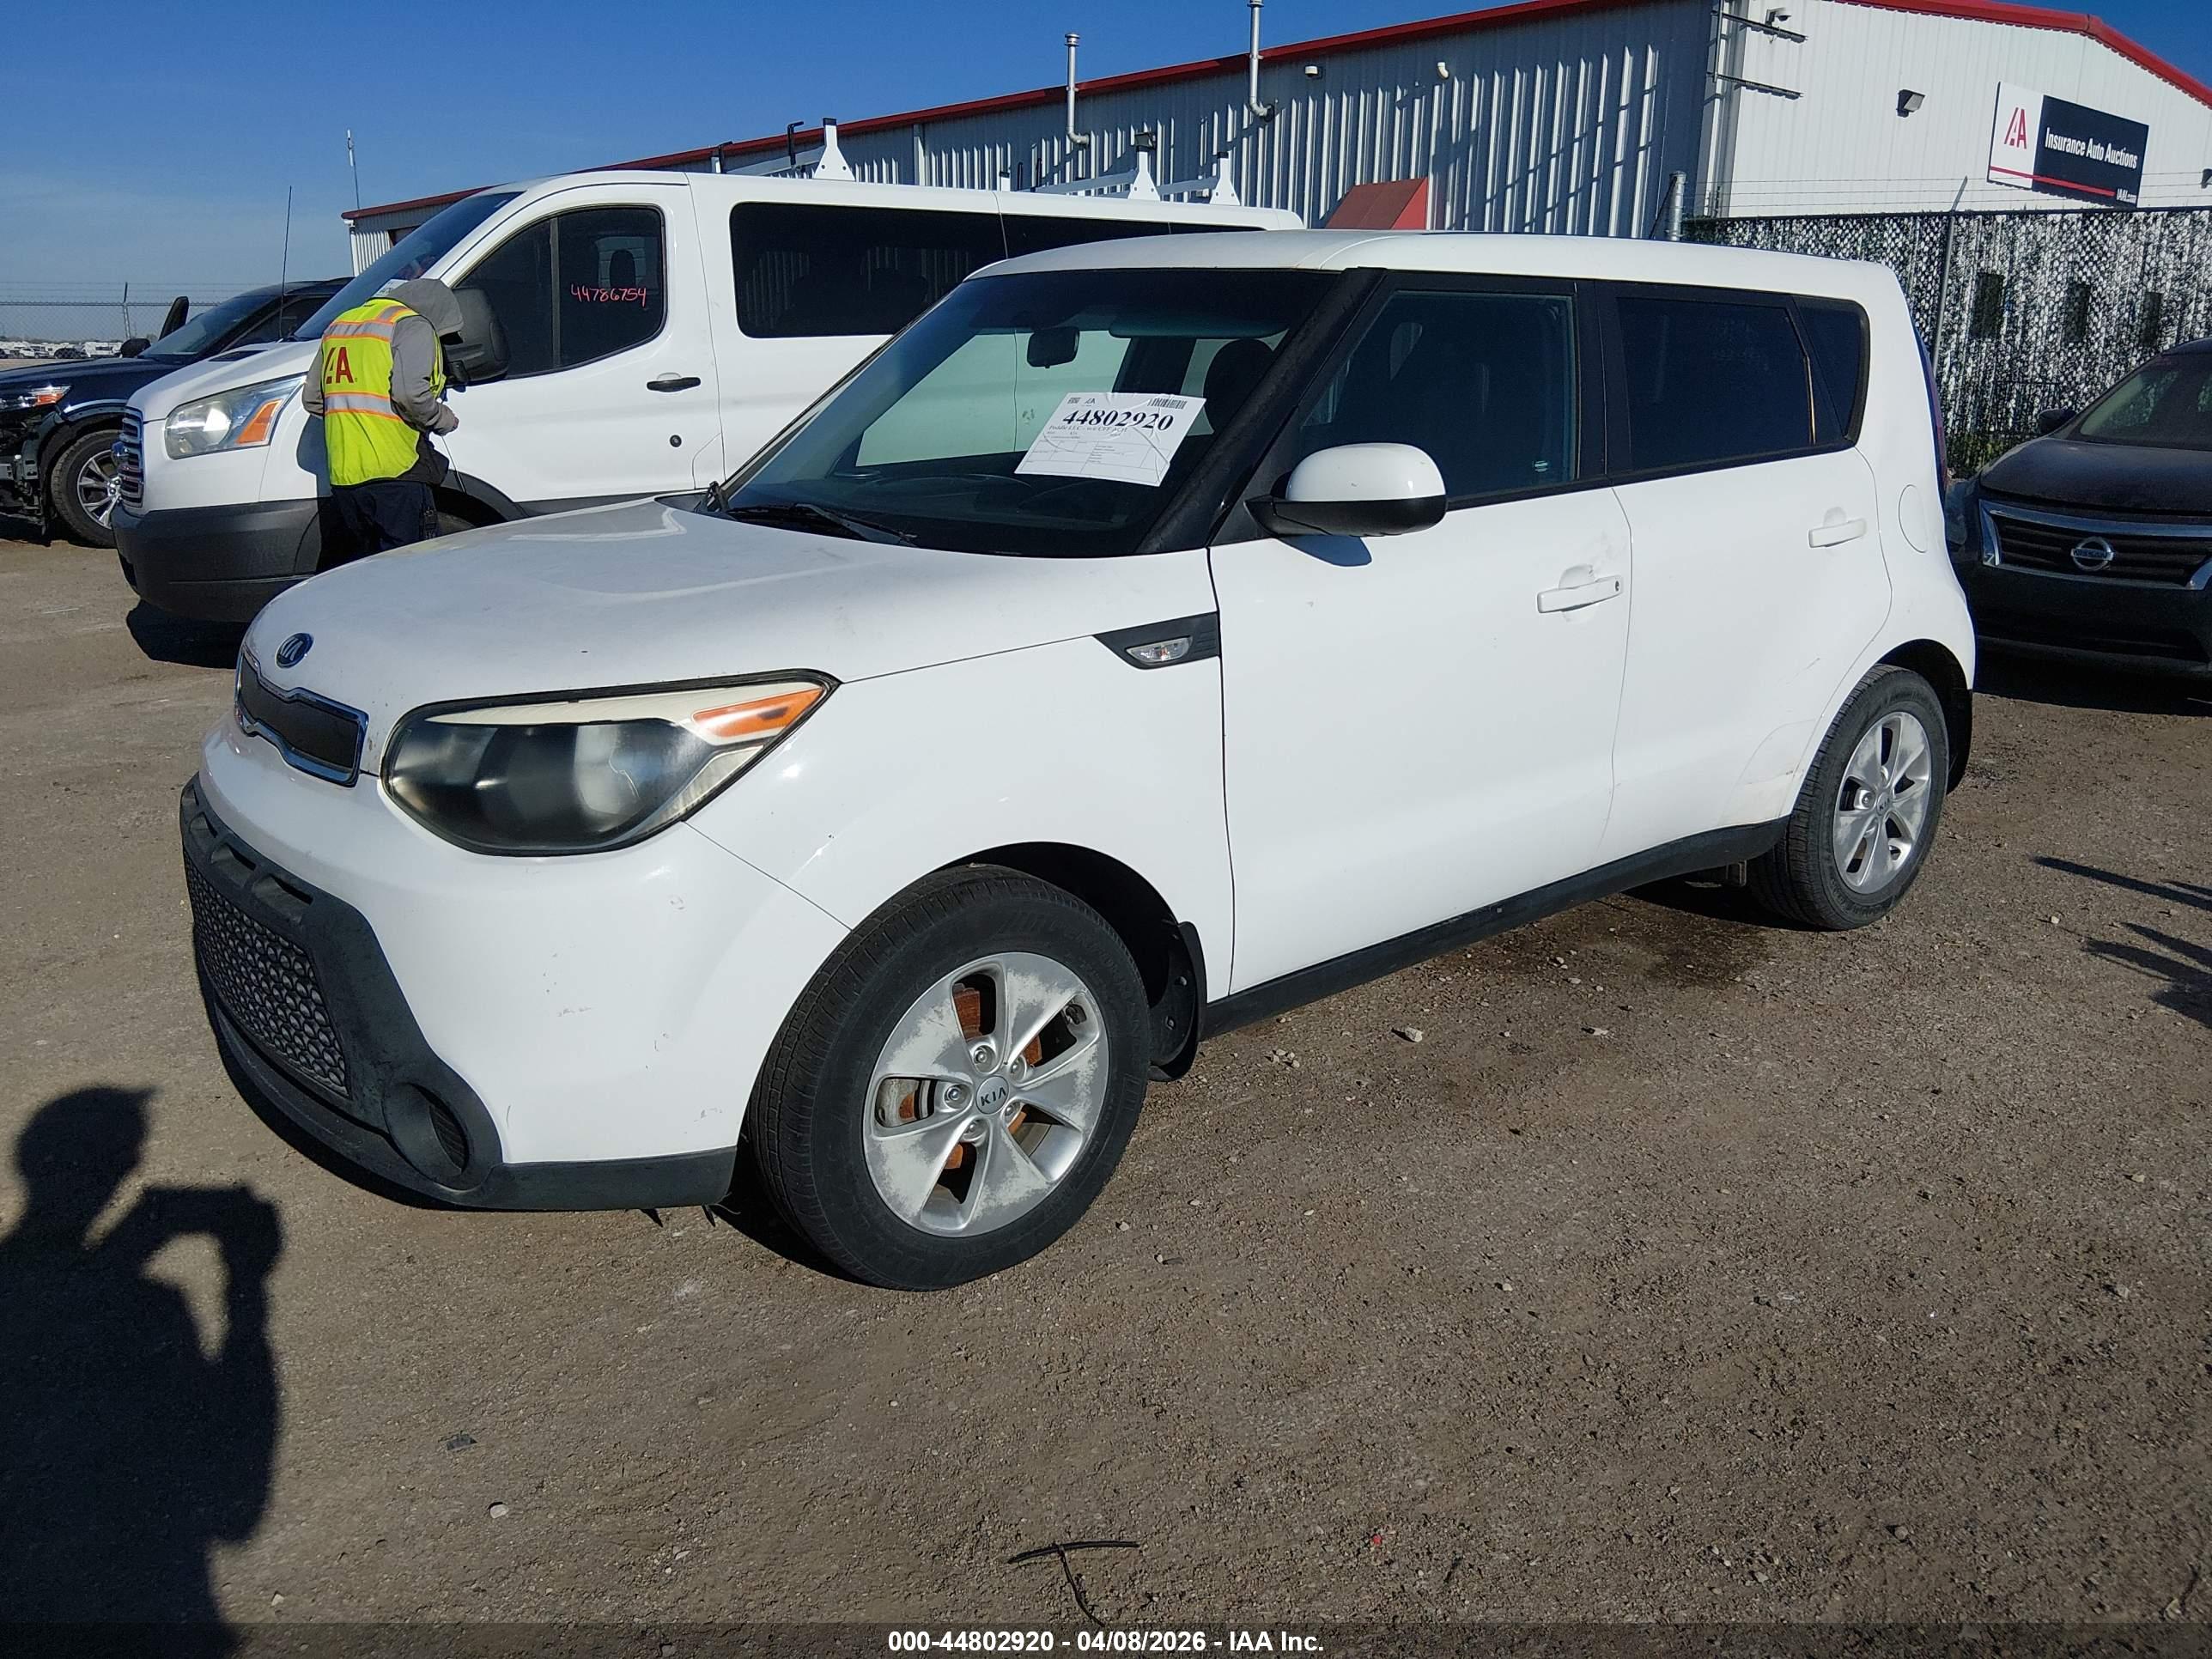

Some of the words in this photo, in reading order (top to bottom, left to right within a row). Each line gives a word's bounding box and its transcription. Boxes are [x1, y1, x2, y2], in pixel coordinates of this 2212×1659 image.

[2045, 127, 2086, 156] Insurance
[2087, 138, 2104, 161] Auto
[2105, 143, 2138, 169] Auctions
[570, 283, 647, 307] 44786754
[1062, 409, 1174, 431] 44802920
[980, 1086, 1006, 1107] KIA
